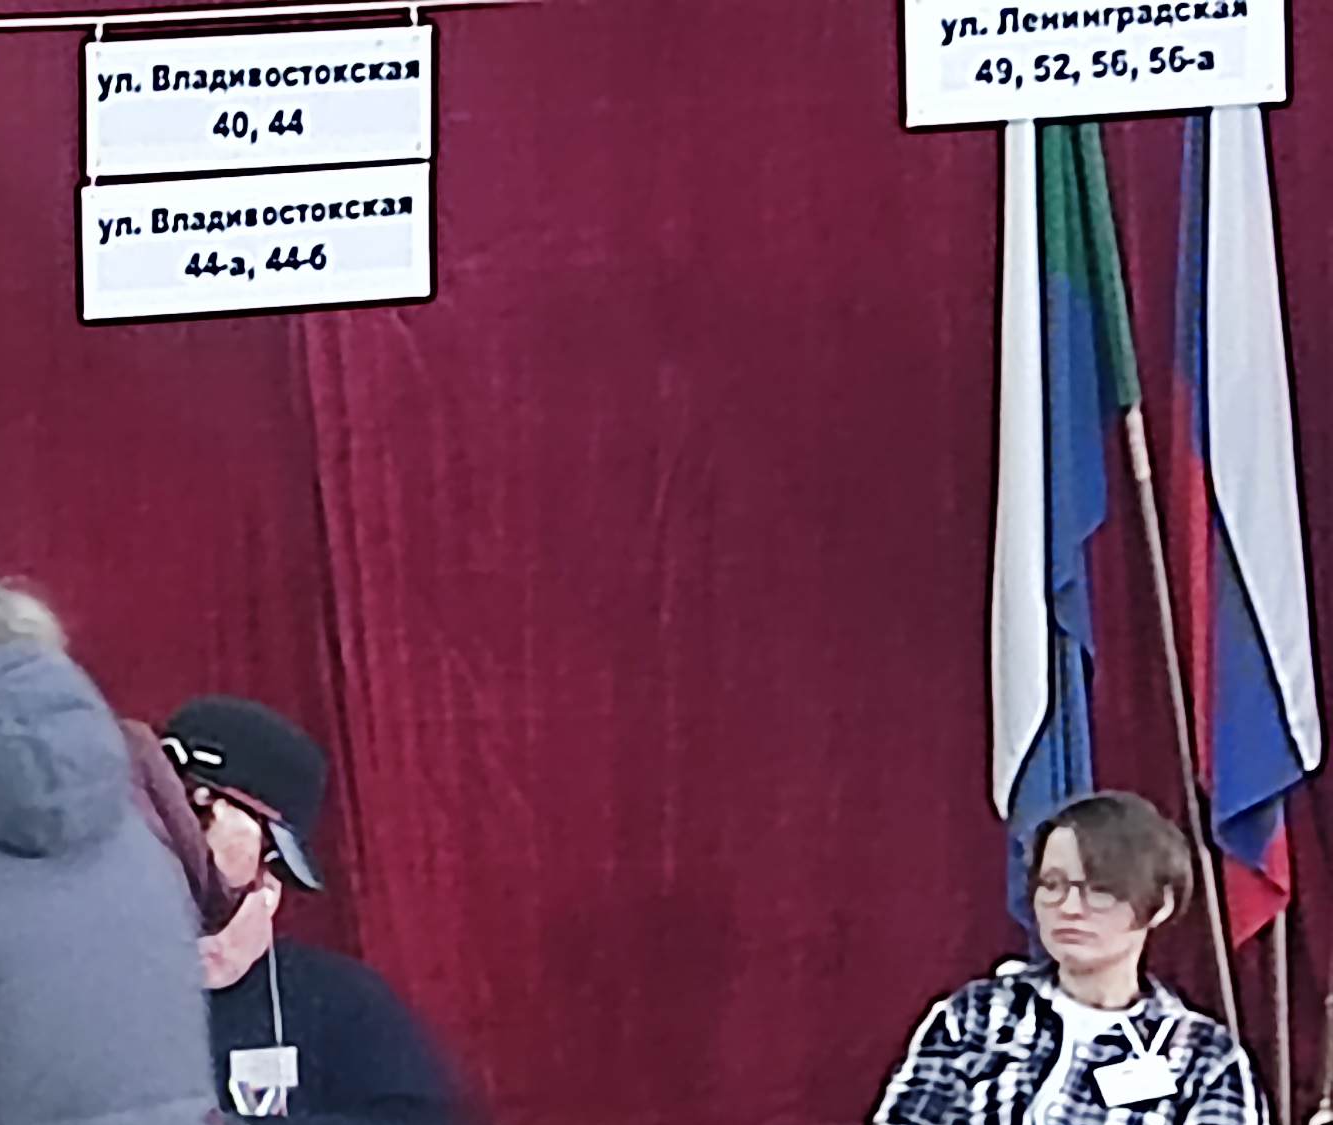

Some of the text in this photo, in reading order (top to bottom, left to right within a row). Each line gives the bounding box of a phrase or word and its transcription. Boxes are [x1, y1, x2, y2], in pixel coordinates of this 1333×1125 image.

[941, 0, 1248, 46] ул. Ленинградская
[98, 60, 420, 102] ул. Владивостокская
[975, 46, 1214, 89] 49, 52, 56, 56-а
[213, 109, 304, 144] 40, 44
[98, 196, 413, 244] ул. Владивостокская
[185, 243, 327, 280] 44-а, 44-б
